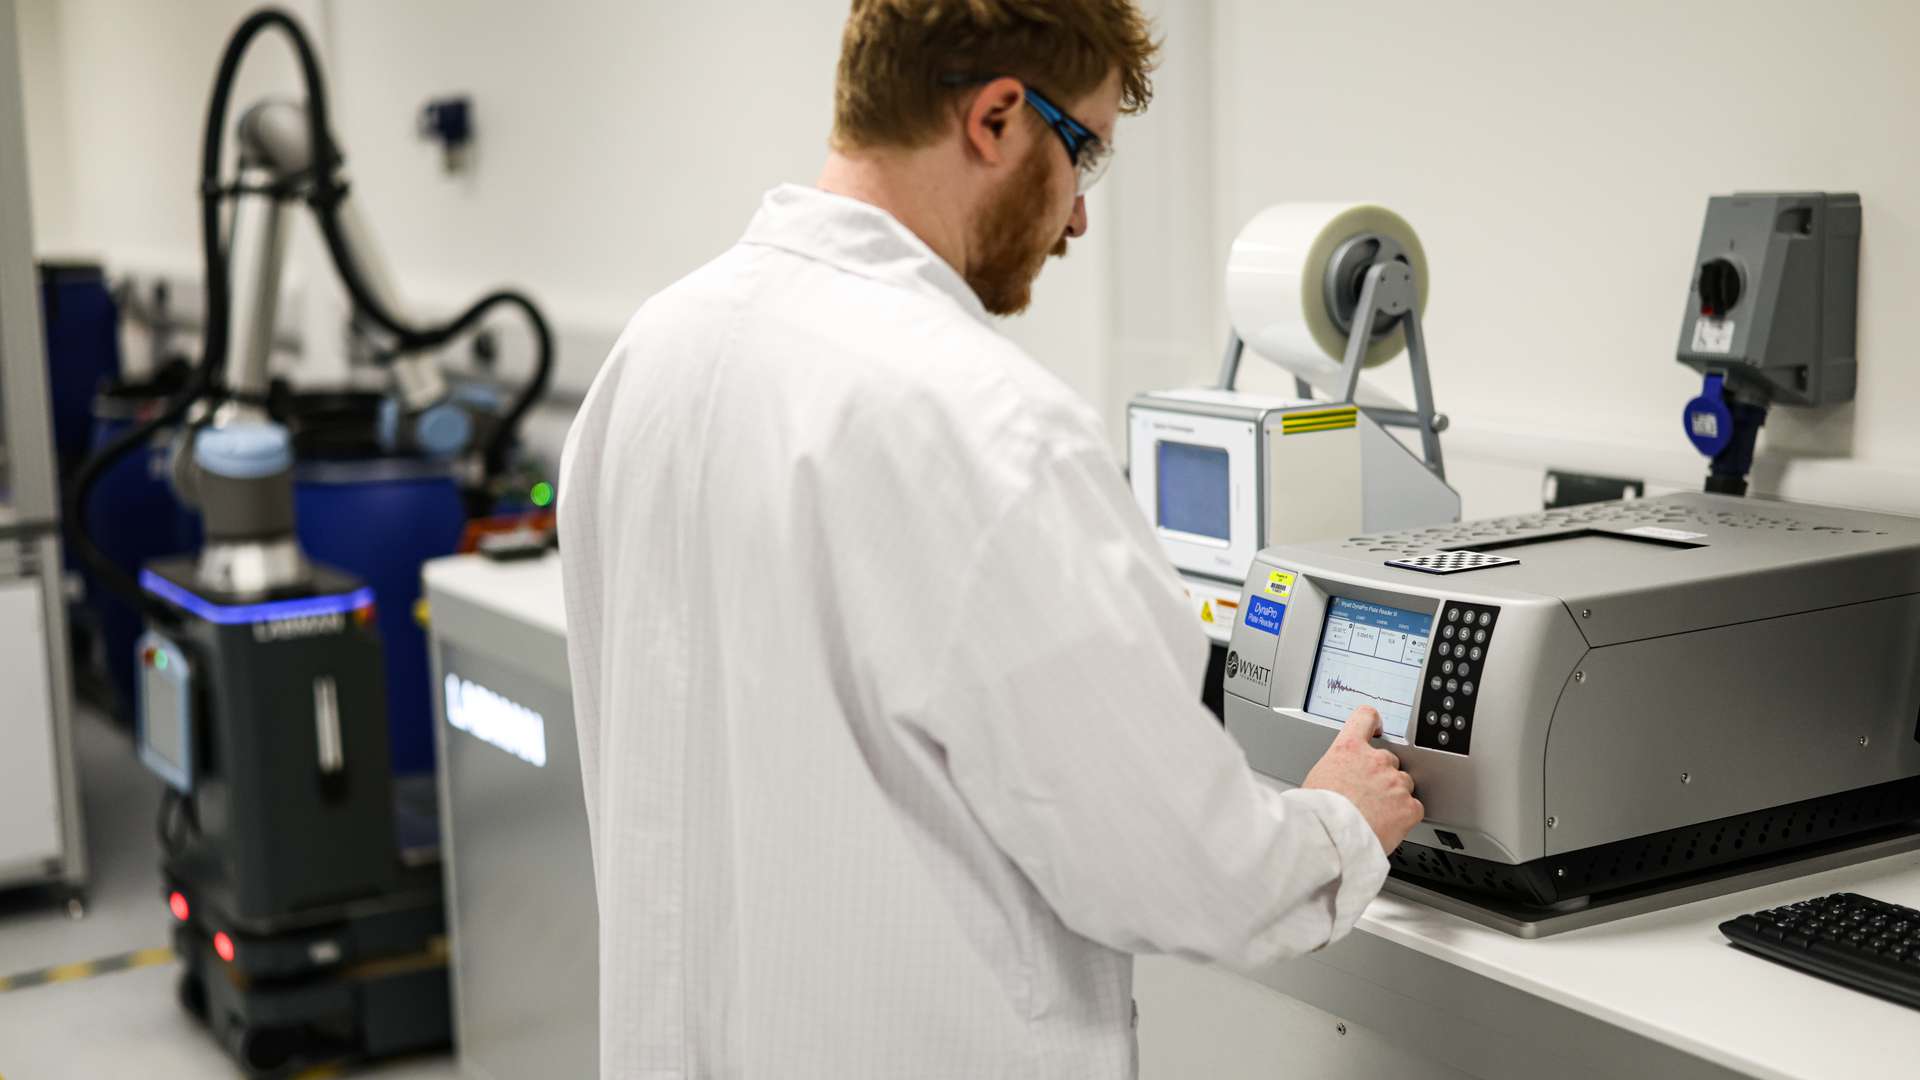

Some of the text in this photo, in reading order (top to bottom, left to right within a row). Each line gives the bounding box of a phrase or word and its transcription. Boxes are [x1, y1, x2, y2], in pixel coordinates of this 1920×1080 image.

[1254, 602, 1278, 620] DynaPro
[1466, 613, 1472, 622] 8
[1482, 615, 1488, 624] 9
[1461, 630, 1467, 639] 5
[1477, 632, 1483, 641] 6
[1456, 647, 1463, 656] 2
[1471, 649, 1478, 658] 3
[1239, 658, 1271, 683] WYATT
[1444, 663, 1451, 672] 0
